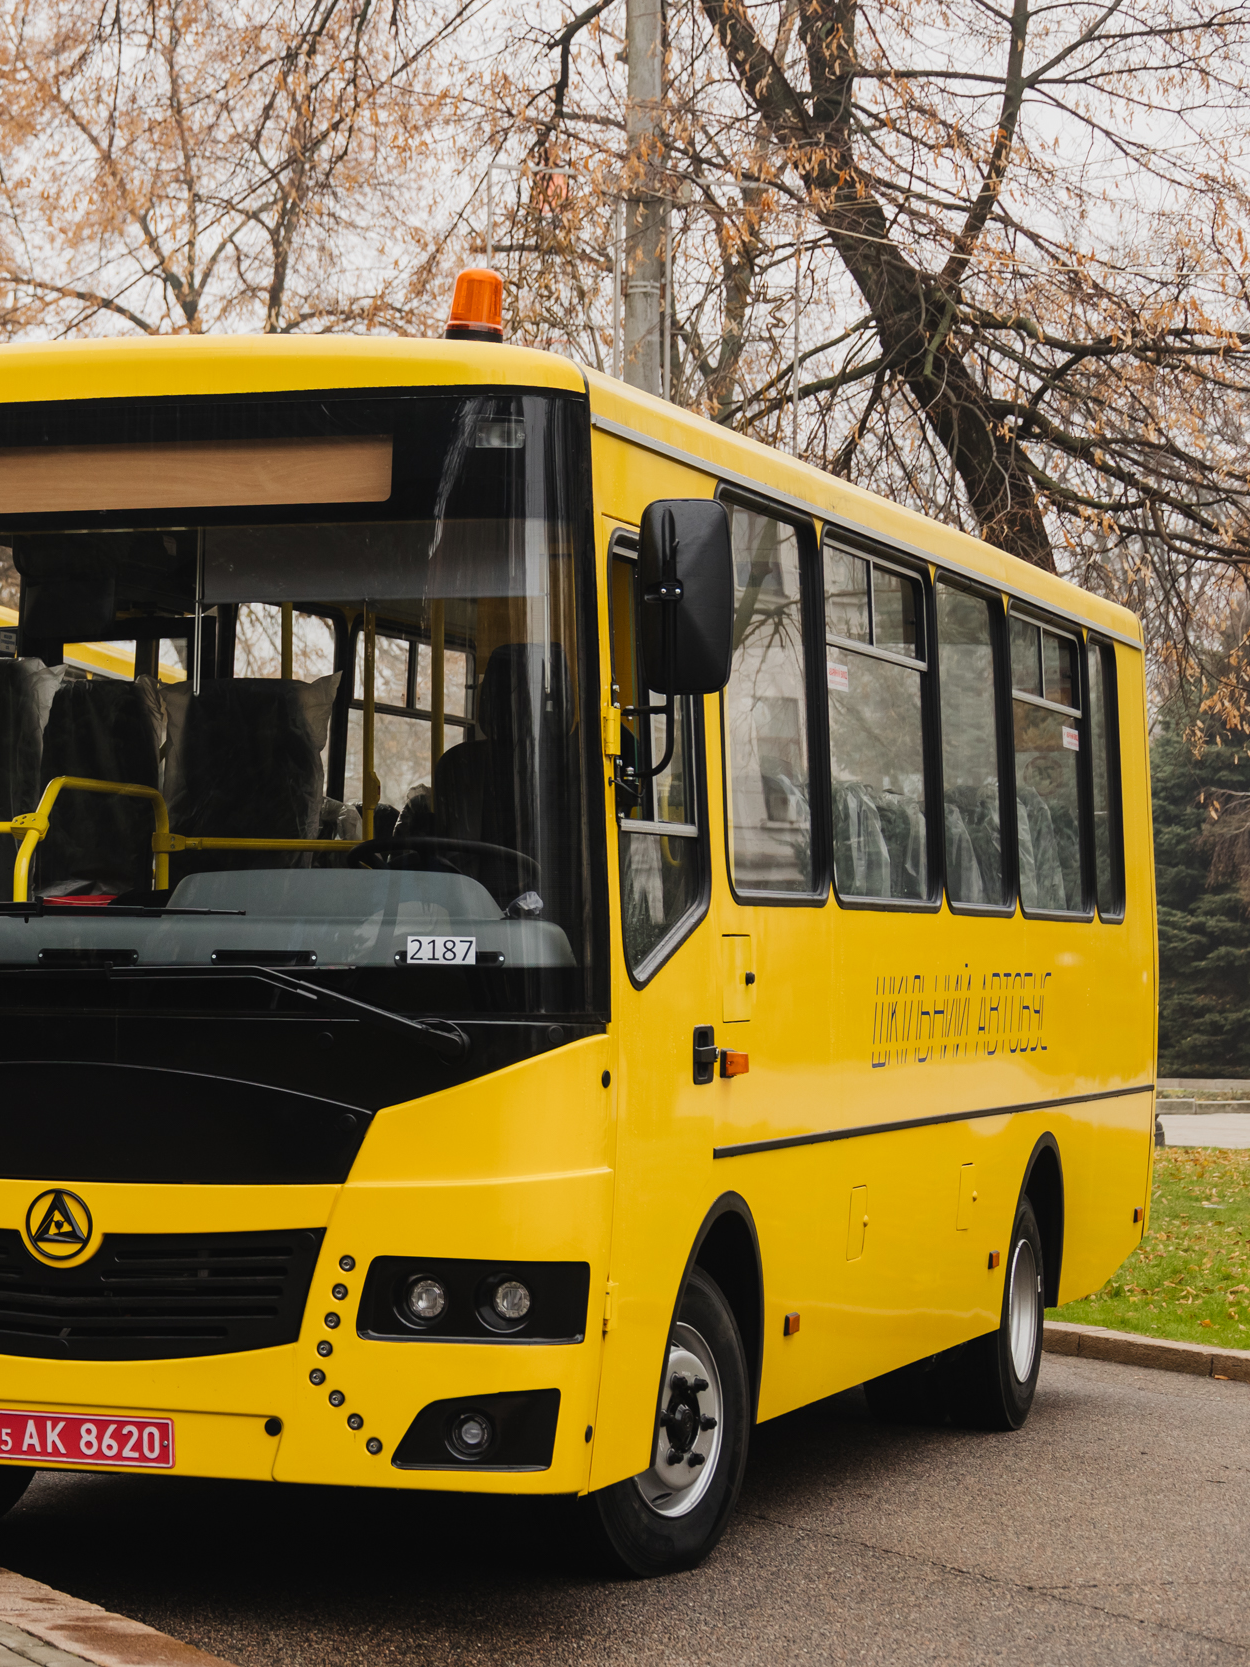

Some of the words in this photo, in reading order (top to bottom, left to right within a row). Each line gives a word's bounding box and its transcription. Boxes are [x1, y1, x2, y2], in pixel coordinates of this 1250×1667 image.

[409, 938, 474, 962] 2187
[871, 963, 972, 1069] ШКІЛЬНИЙ
[975, 972, 1052, 1056] АВТОБУС
[21, 1419, 68, 1455] AK
[79, 1422, 161, 1460] 8620
